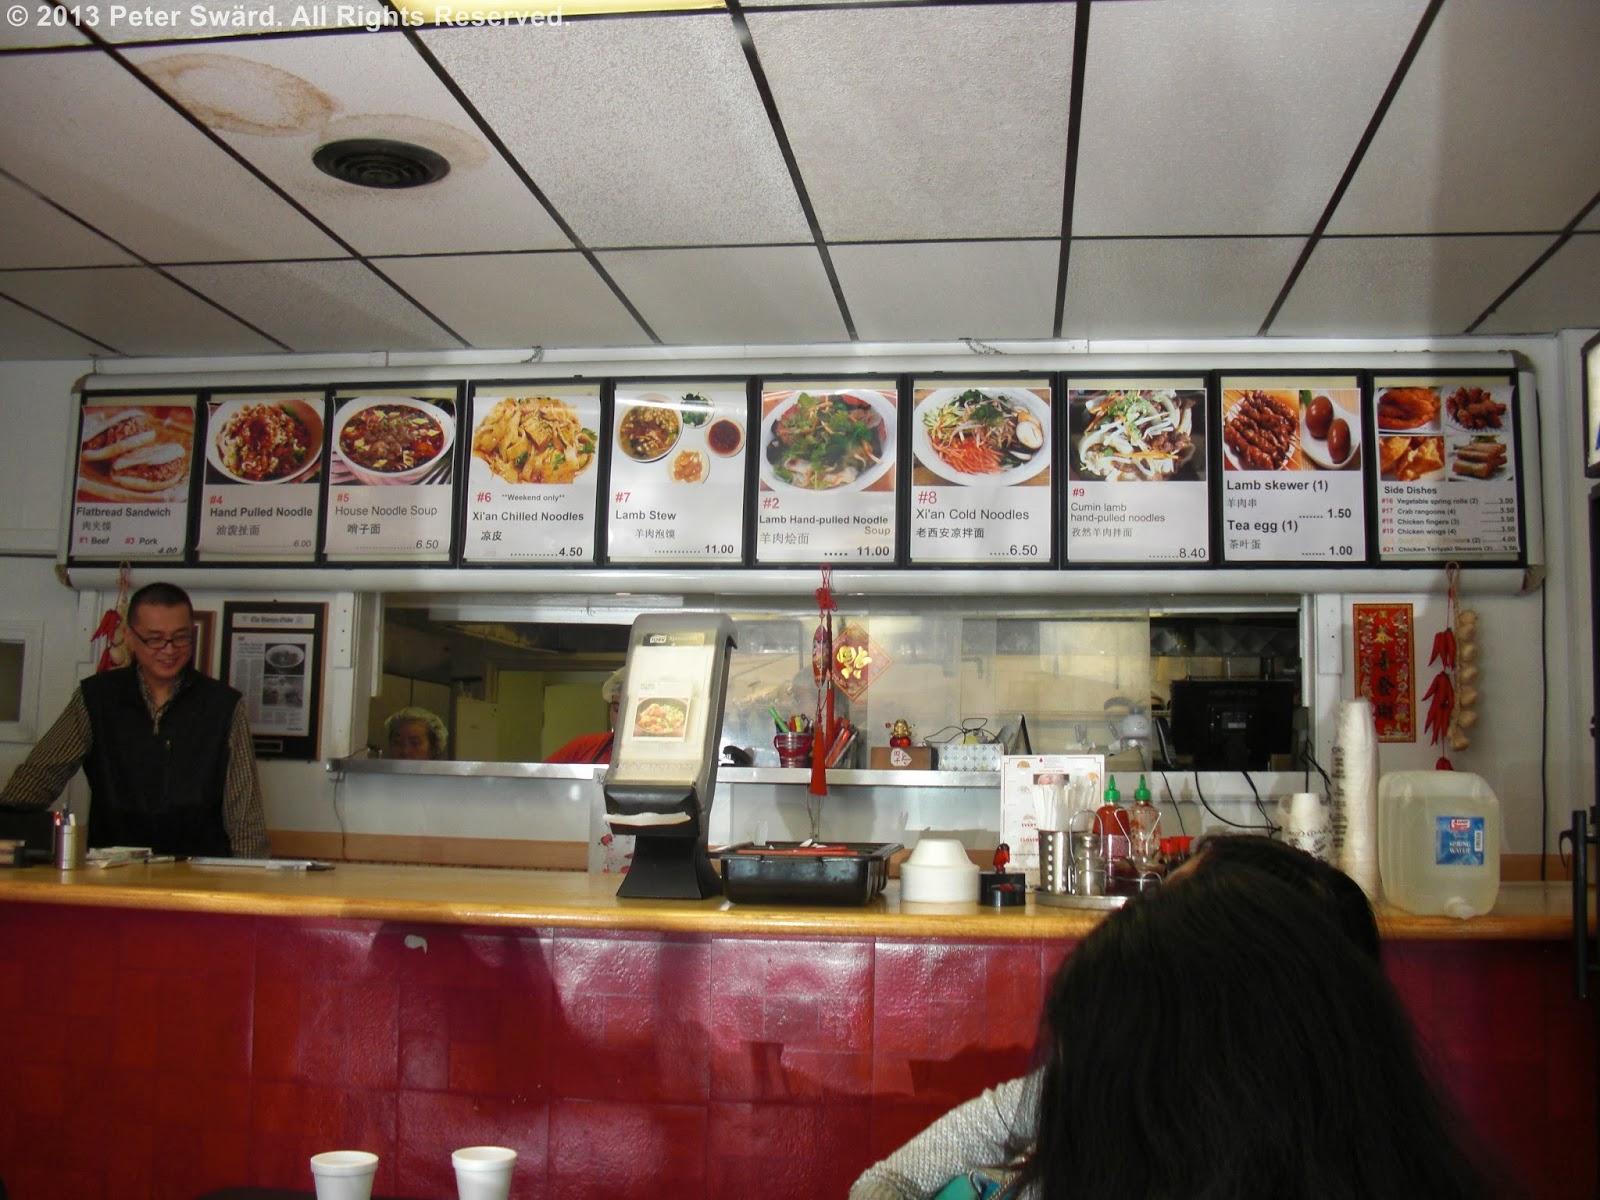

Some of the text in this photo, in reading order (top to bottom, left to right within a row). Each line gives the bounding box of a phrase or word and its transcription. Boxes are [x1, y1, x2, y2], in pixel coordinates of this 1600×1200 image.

[1227, 479, 1329, 492] Lamb skewer (1)
[1384, 486, 1438, 494] Side Dishes
[337, 493, 349, 503] #5
[477, 491, 492, 503] #6
[615, 492, 631, 503] #7
[918, 491, 937, 504] #8
[1072, 488, 1085, 497] #9
[209, 495, 223, 505] #4
[763, 497, 780, 509] #2
[1430, 498, 1451, 506] spring
[76, 506, 171, 517] Flatbread Sandwich
[210, 506, 313, 517] Hand Pulled Noodle
[335, 505, 438, 517] House Noodle Soup
[1070, 502, 1127, 512] Cumin lamb
[1327, 507, 1352, 518] 1.50
[1414, 508, 1446, 516] rangoons
[473, 511, 584, 521] Xi'an Chilled Noodles
[615, 510, 677, 520] Lamb Stew
[915, 508, 1030, 520] Xi'an Cold Noodles
[1070, 513, 1166, 523] hand-pulled noodles
[759, 515, 889, 526] Lamb Hand-pulled Noodle
[1425, 518, 1449, 526] fingers
[864, 526, 891, 536] Soup
[1227, 520, 1298, 533] Tea egg (1)
[91, 536, 110, 545] Beef
[124, 537, 158, 545] #3 Pork
[293, 539, 312, 548] 6.00
[415, 539, 439, 550] 6.50
[559, 546, 583, 557] 4.50
[705, 544, 734, 554] 11.00
[857, 545, 890, 556] 11.00
[1009, 544, 1038, 556] 6.50
[1179, 547, 1207, 559] 8.40
[1329, 545, 1353, 556] 1.00
